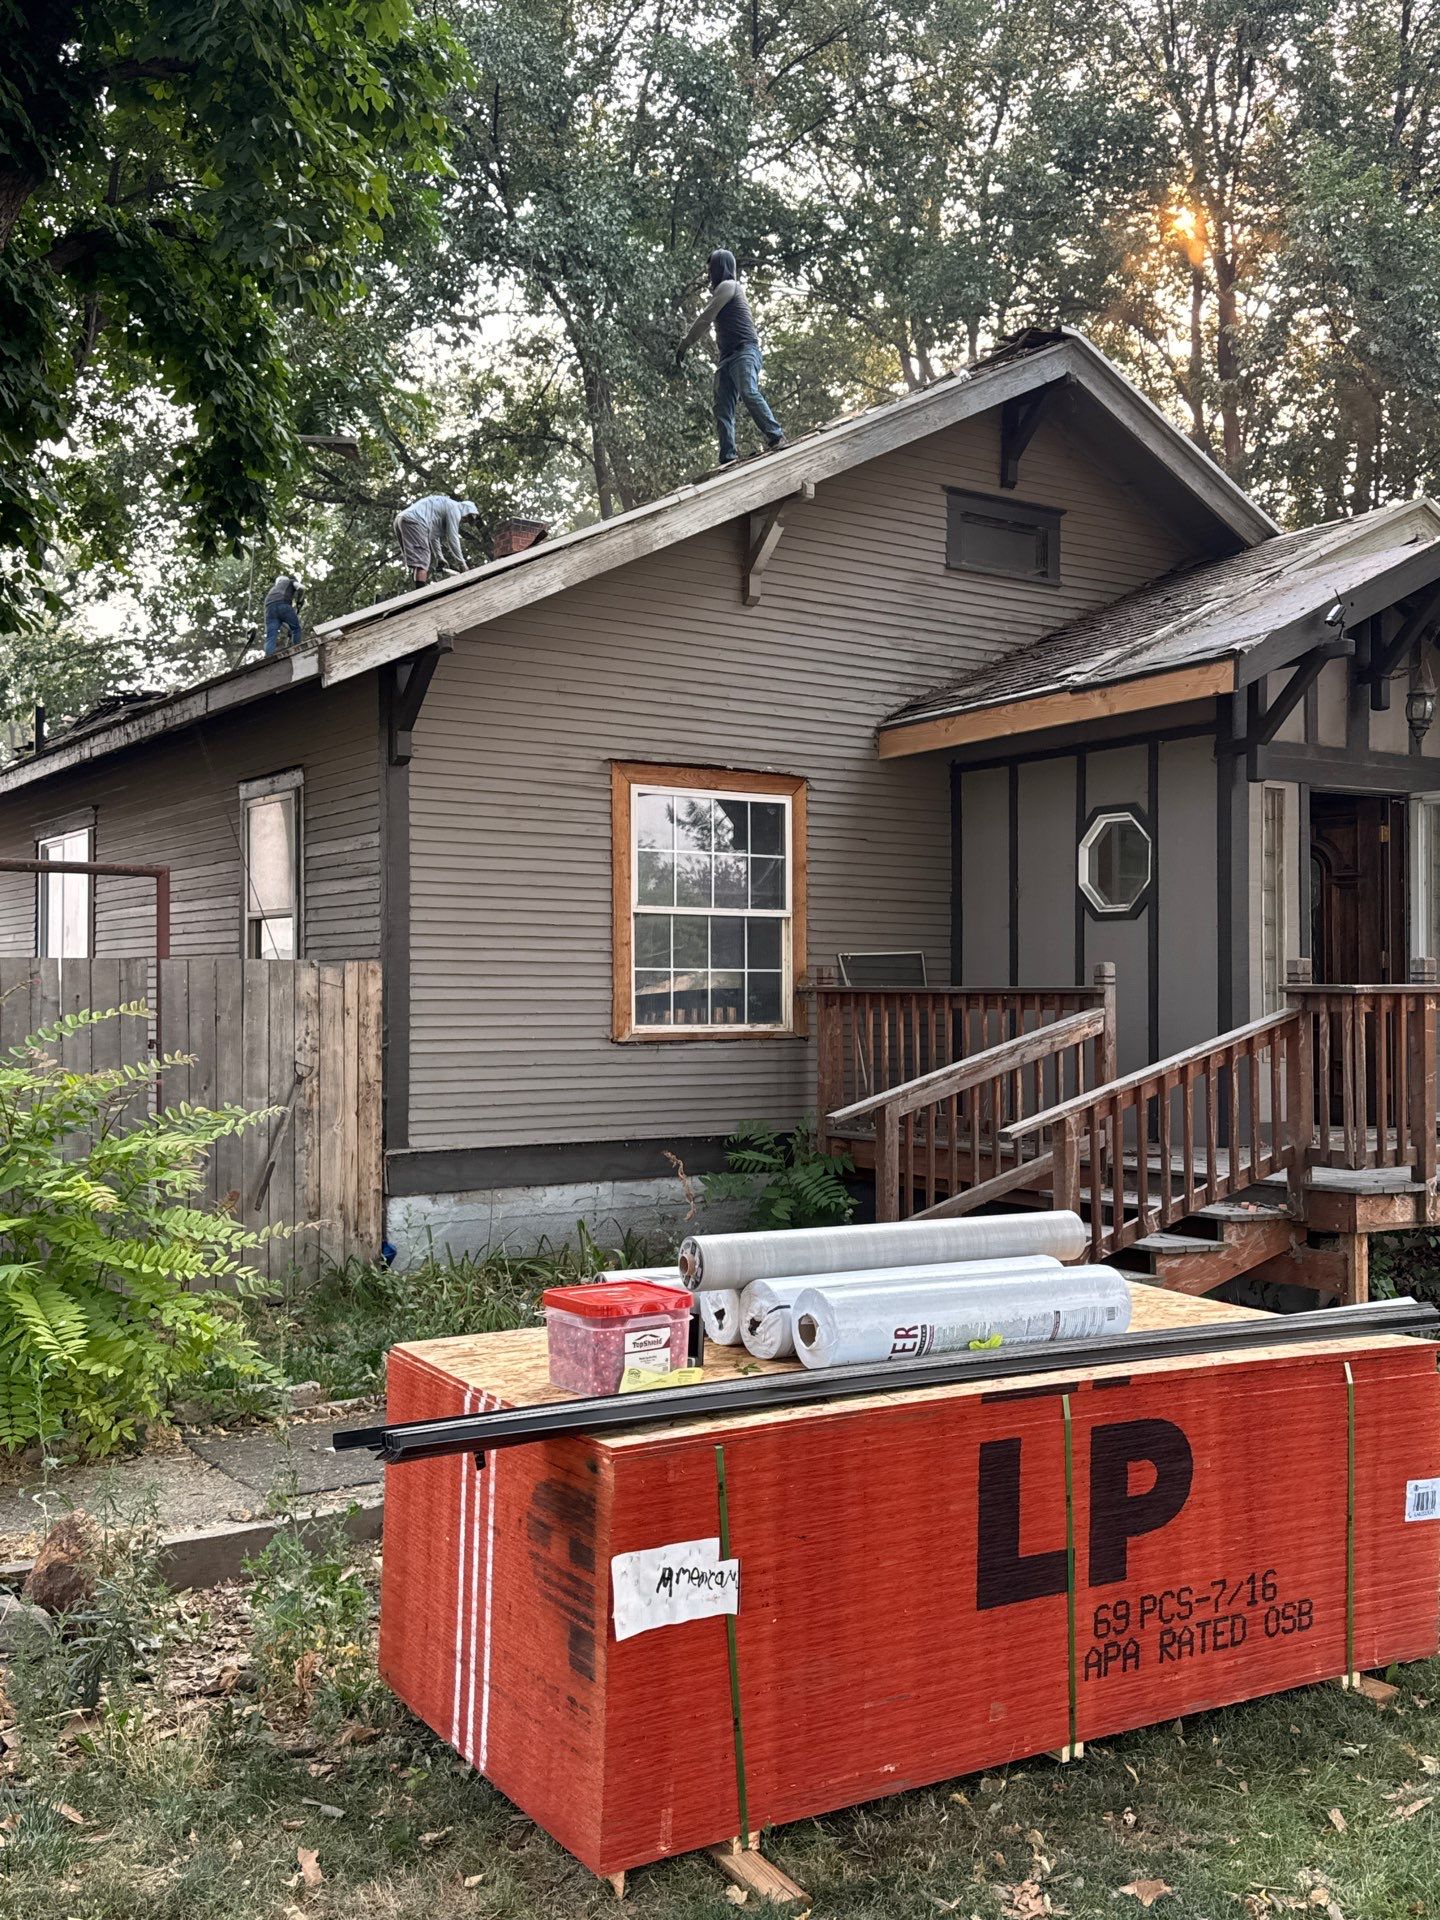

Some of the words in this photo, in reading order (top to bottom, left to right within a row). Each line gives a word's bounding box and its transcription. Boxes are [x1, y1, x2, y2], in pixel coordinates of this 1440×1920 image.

[632, 1338, 663, 1349] TopShield
[977, 1418, 1193, 1610] LP
[1084, 1638, 1141, 1681] APA
[1158, 1613, 1247, 1664] RATED
[1264, 1599, 1314, 1639] OSB
[1093, 1600, 1131, 1639] 69
[1139, 1569, 1278, 1630] PCS-7/16
